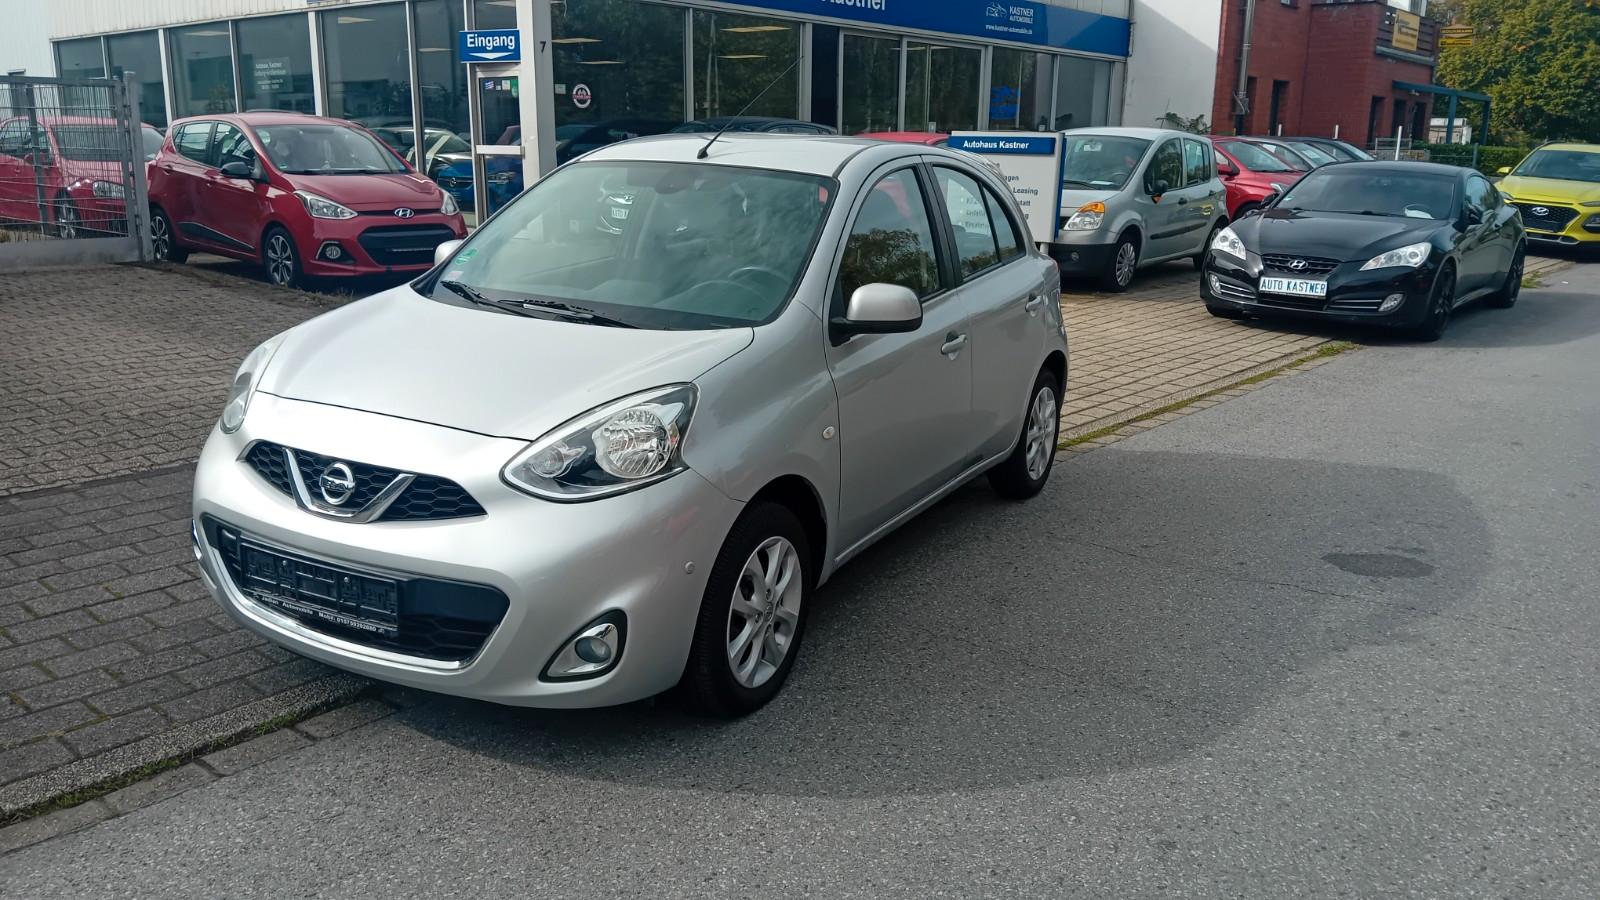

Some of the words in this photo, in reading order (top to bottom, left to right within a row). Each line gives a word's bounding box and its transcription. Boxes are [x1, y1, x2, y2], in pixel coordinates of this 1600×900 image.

[1010, 6, 1034, 17] KASTNER
[467, 33, 515, 50] Eingang
[540, 41, 546, 53] 7
[963, 140, 997, 149] Autohaus
[999, 140, 1029, 149] Kastner
[1013, 186, 1038, 195] Leasing
[1261, 279, 1283, 290] AUTO
[1287, 280, 1326, 294] KASTNER
